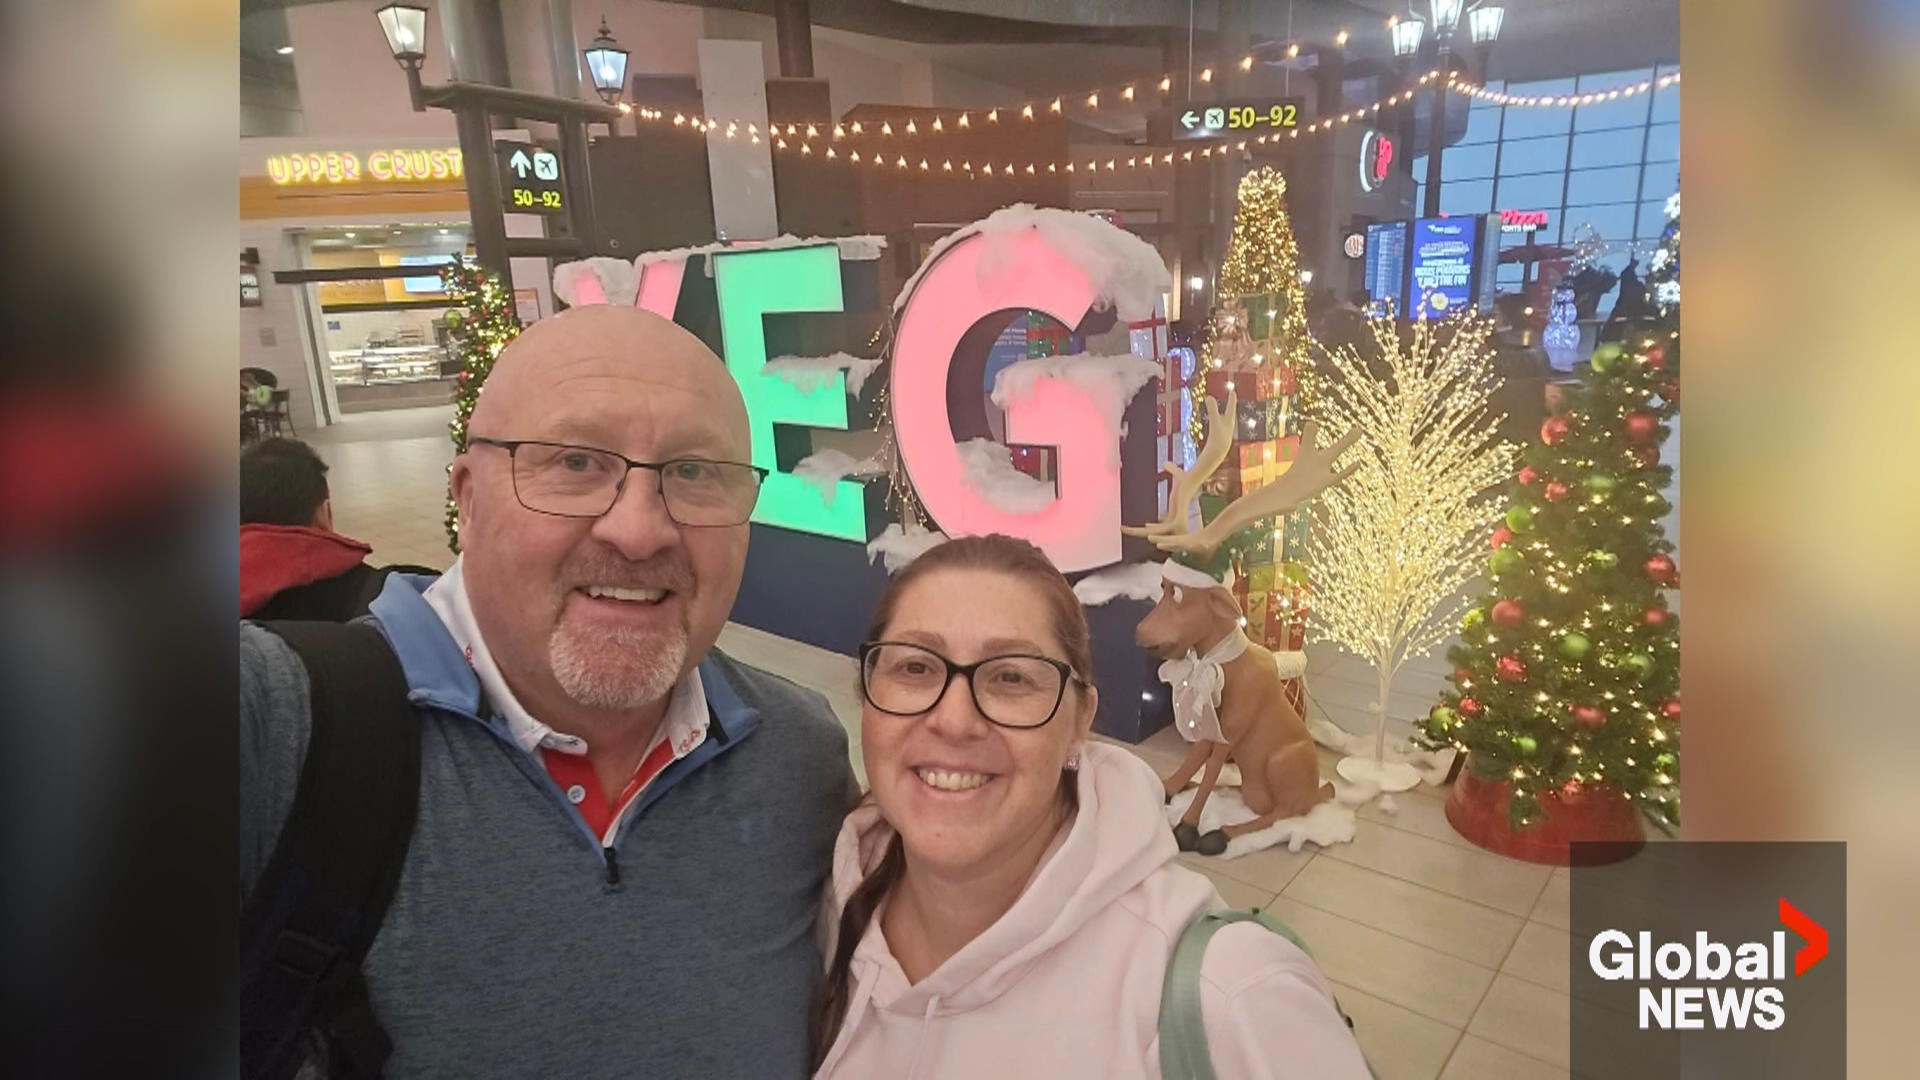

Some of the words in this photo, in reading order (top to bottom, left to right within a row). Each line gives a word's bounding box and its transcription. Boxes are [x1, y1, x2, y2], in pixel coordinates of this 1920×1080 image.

[268, 153, 361, 184] UPPER
[368, 149, 463, 180] CRUST
[1501, 209, 1548, 225] Pizza
